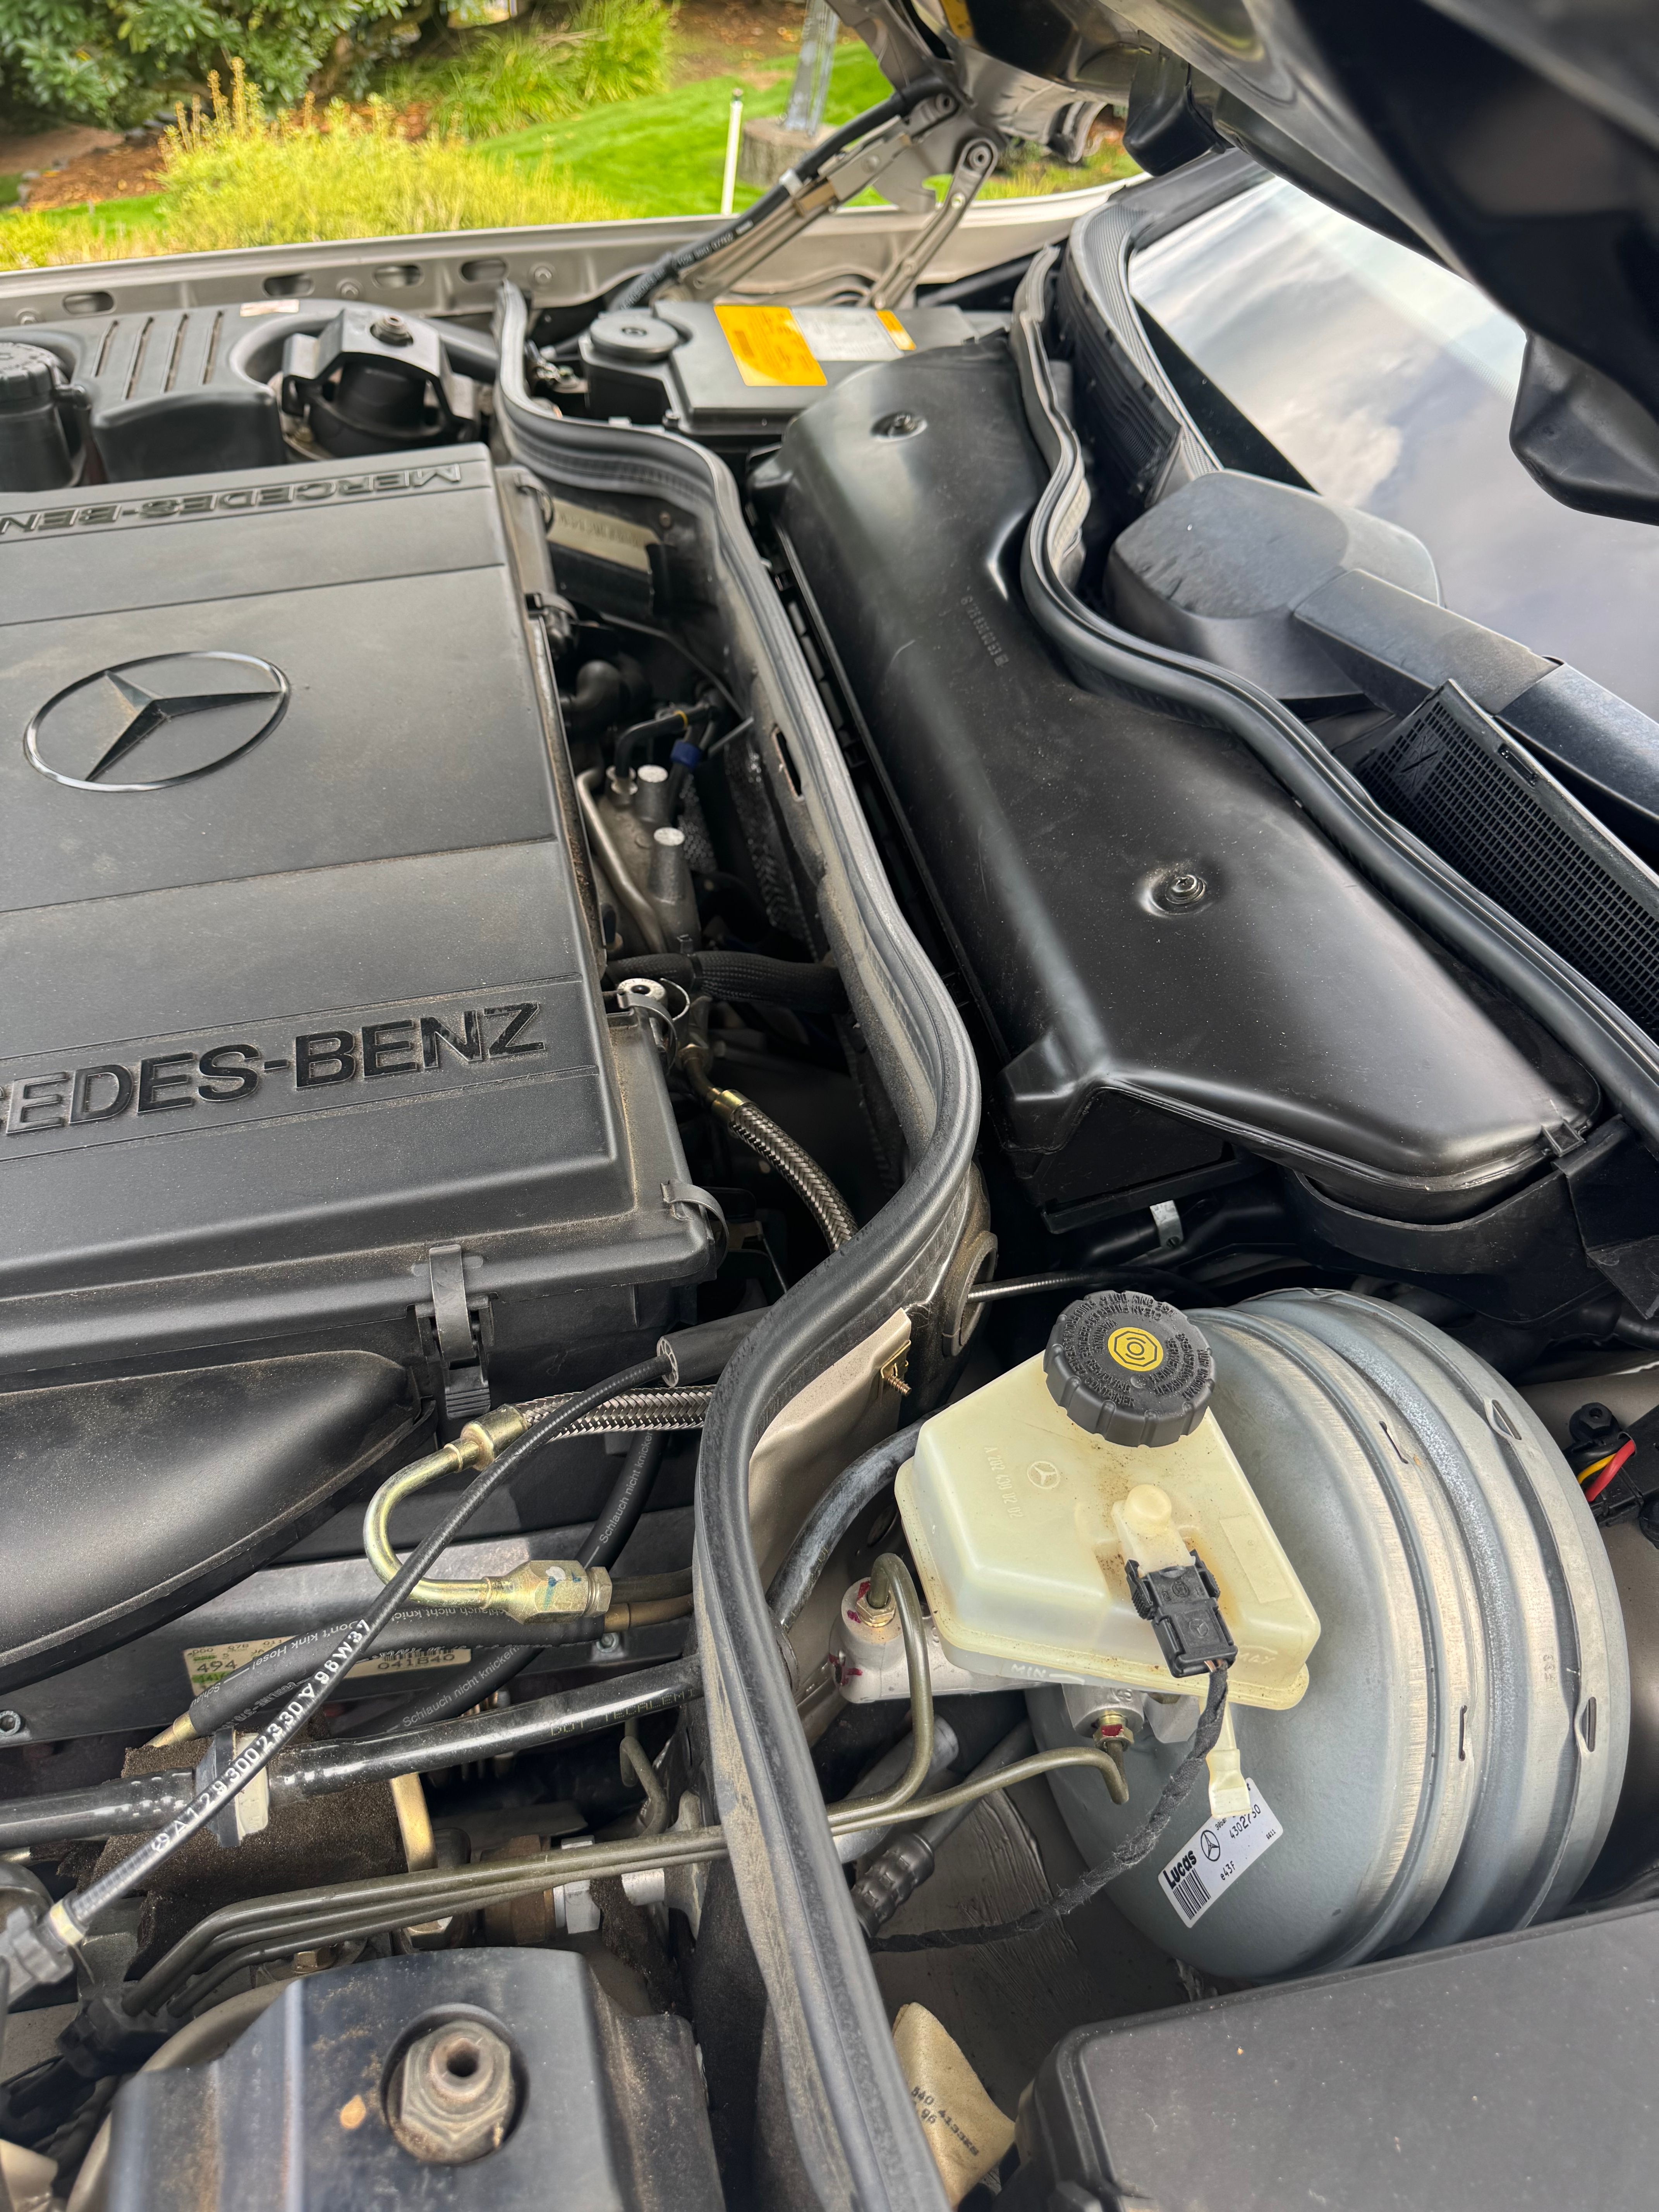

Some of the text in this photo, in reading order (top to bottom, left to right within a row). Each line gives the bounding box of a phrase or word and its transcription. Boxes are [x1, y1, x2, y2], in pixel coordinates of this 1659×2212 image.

[0, 1001, 545, 1135] EDES-BENZ
[600, 1496, 629, 1544] Schlauch
[626, 1469, 641, 1496] nicht
[292, 1632, 319, 1650] kink
[197, 1660, 237, 1673] 494
[1011, 1664, 1046, 1678] MIN
[402, 1694, 452, 1727] Schlauch
[453, 1675, 479, 1696] nicht
[1162, 1849, 1197, 1890] Lucas
